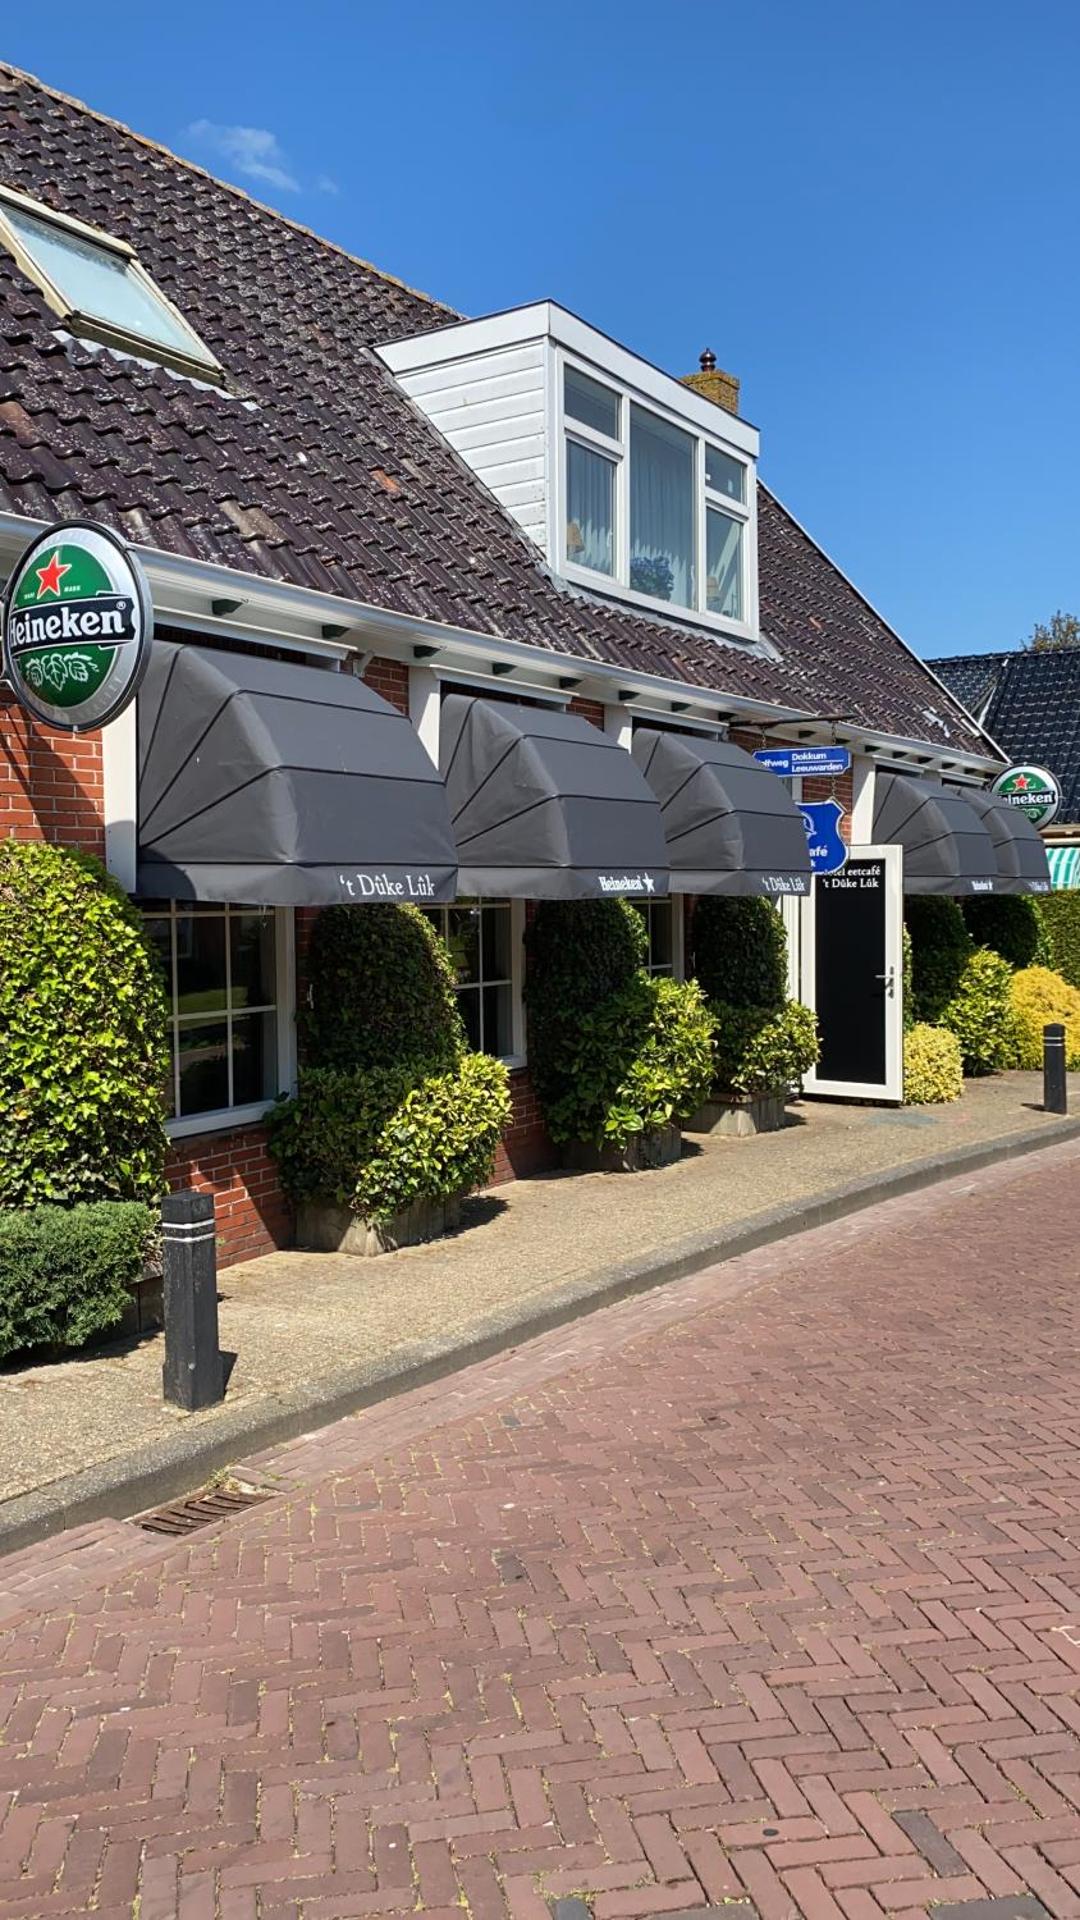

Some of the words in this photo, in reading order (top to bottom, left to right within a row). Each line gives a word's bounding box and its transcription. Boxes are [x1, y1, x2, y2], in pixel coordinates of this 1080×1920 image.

[762, 757, 789, 768] lfweg
[791, 753, 827, 761] Dokkum
[791, 763, 843, 773] Leeuwarden
[1003, 793, 1053, 805] ineken
[809, 845, 828, 857] afé
[847, 865, 880, 876] eetcafé
[340, 874, 355, 896] 't
[356, 873, 404, 896] Dûke
[405, 873, 435, 896] Lûk
[832, 877, 857, 888] Dûke
[860, 878, 879, 888] Lûk
